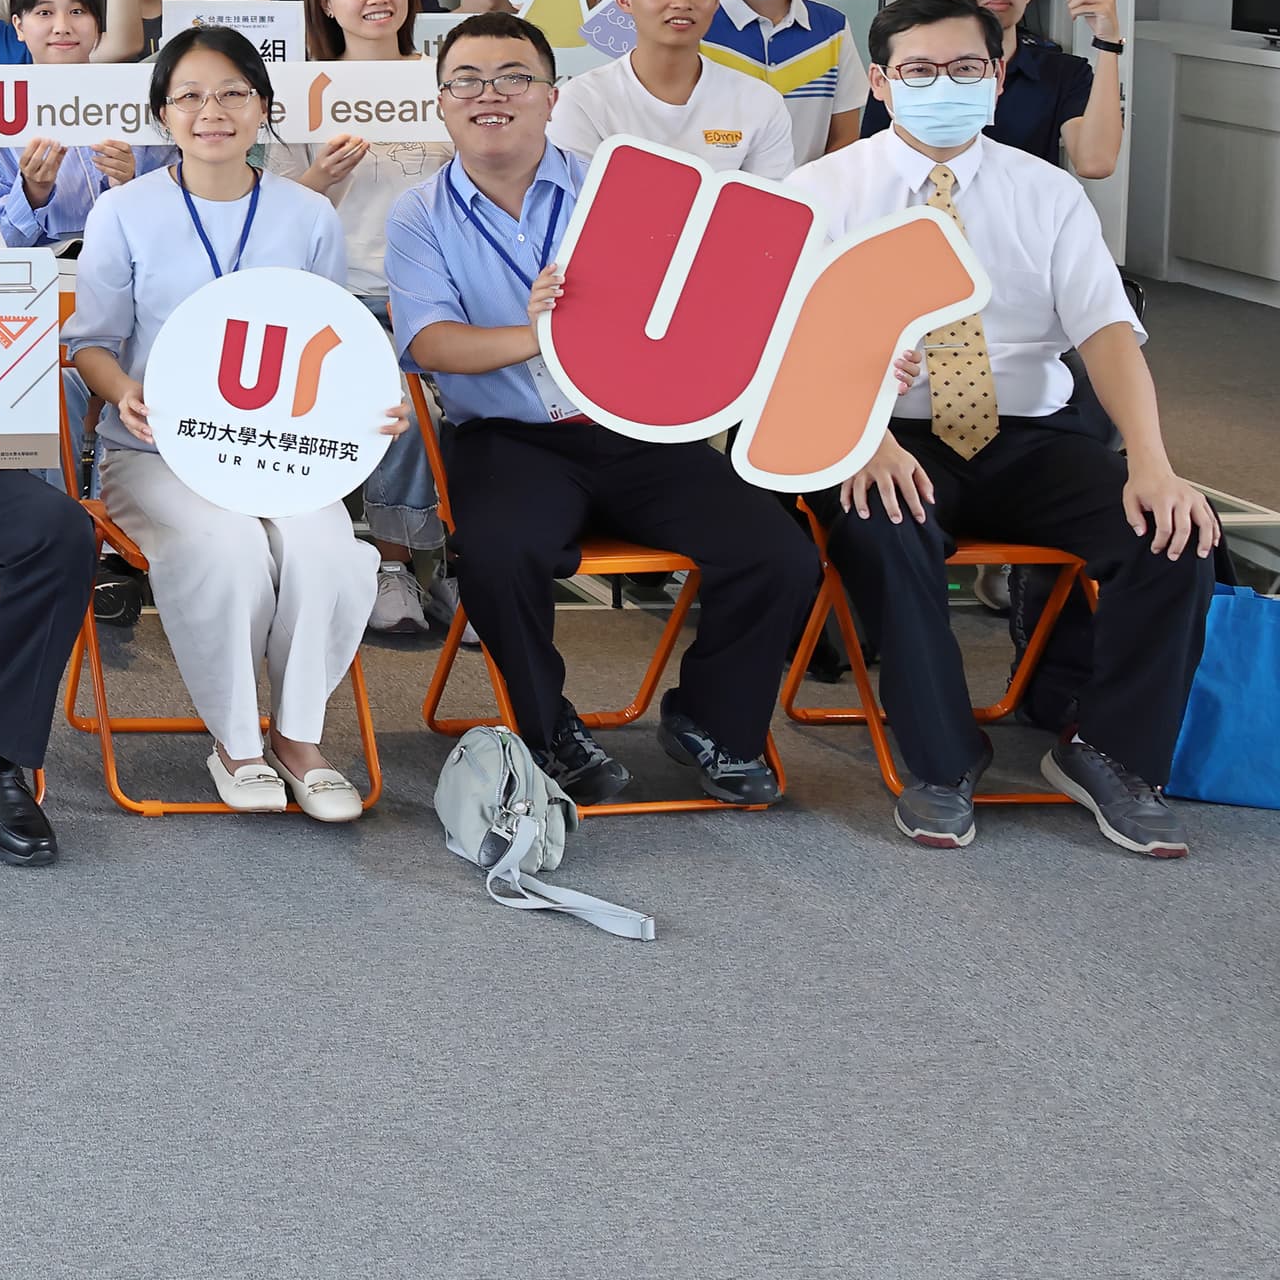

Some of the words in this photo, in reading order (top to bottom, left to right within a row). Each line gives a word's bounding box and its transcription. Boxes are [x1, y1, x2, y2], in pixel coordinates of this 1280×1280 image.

[177, 418, 360, 462] 成功大學大學部研究
[218, 453, 242, 466] UR
[257, 459, 311, 476] NCKU
